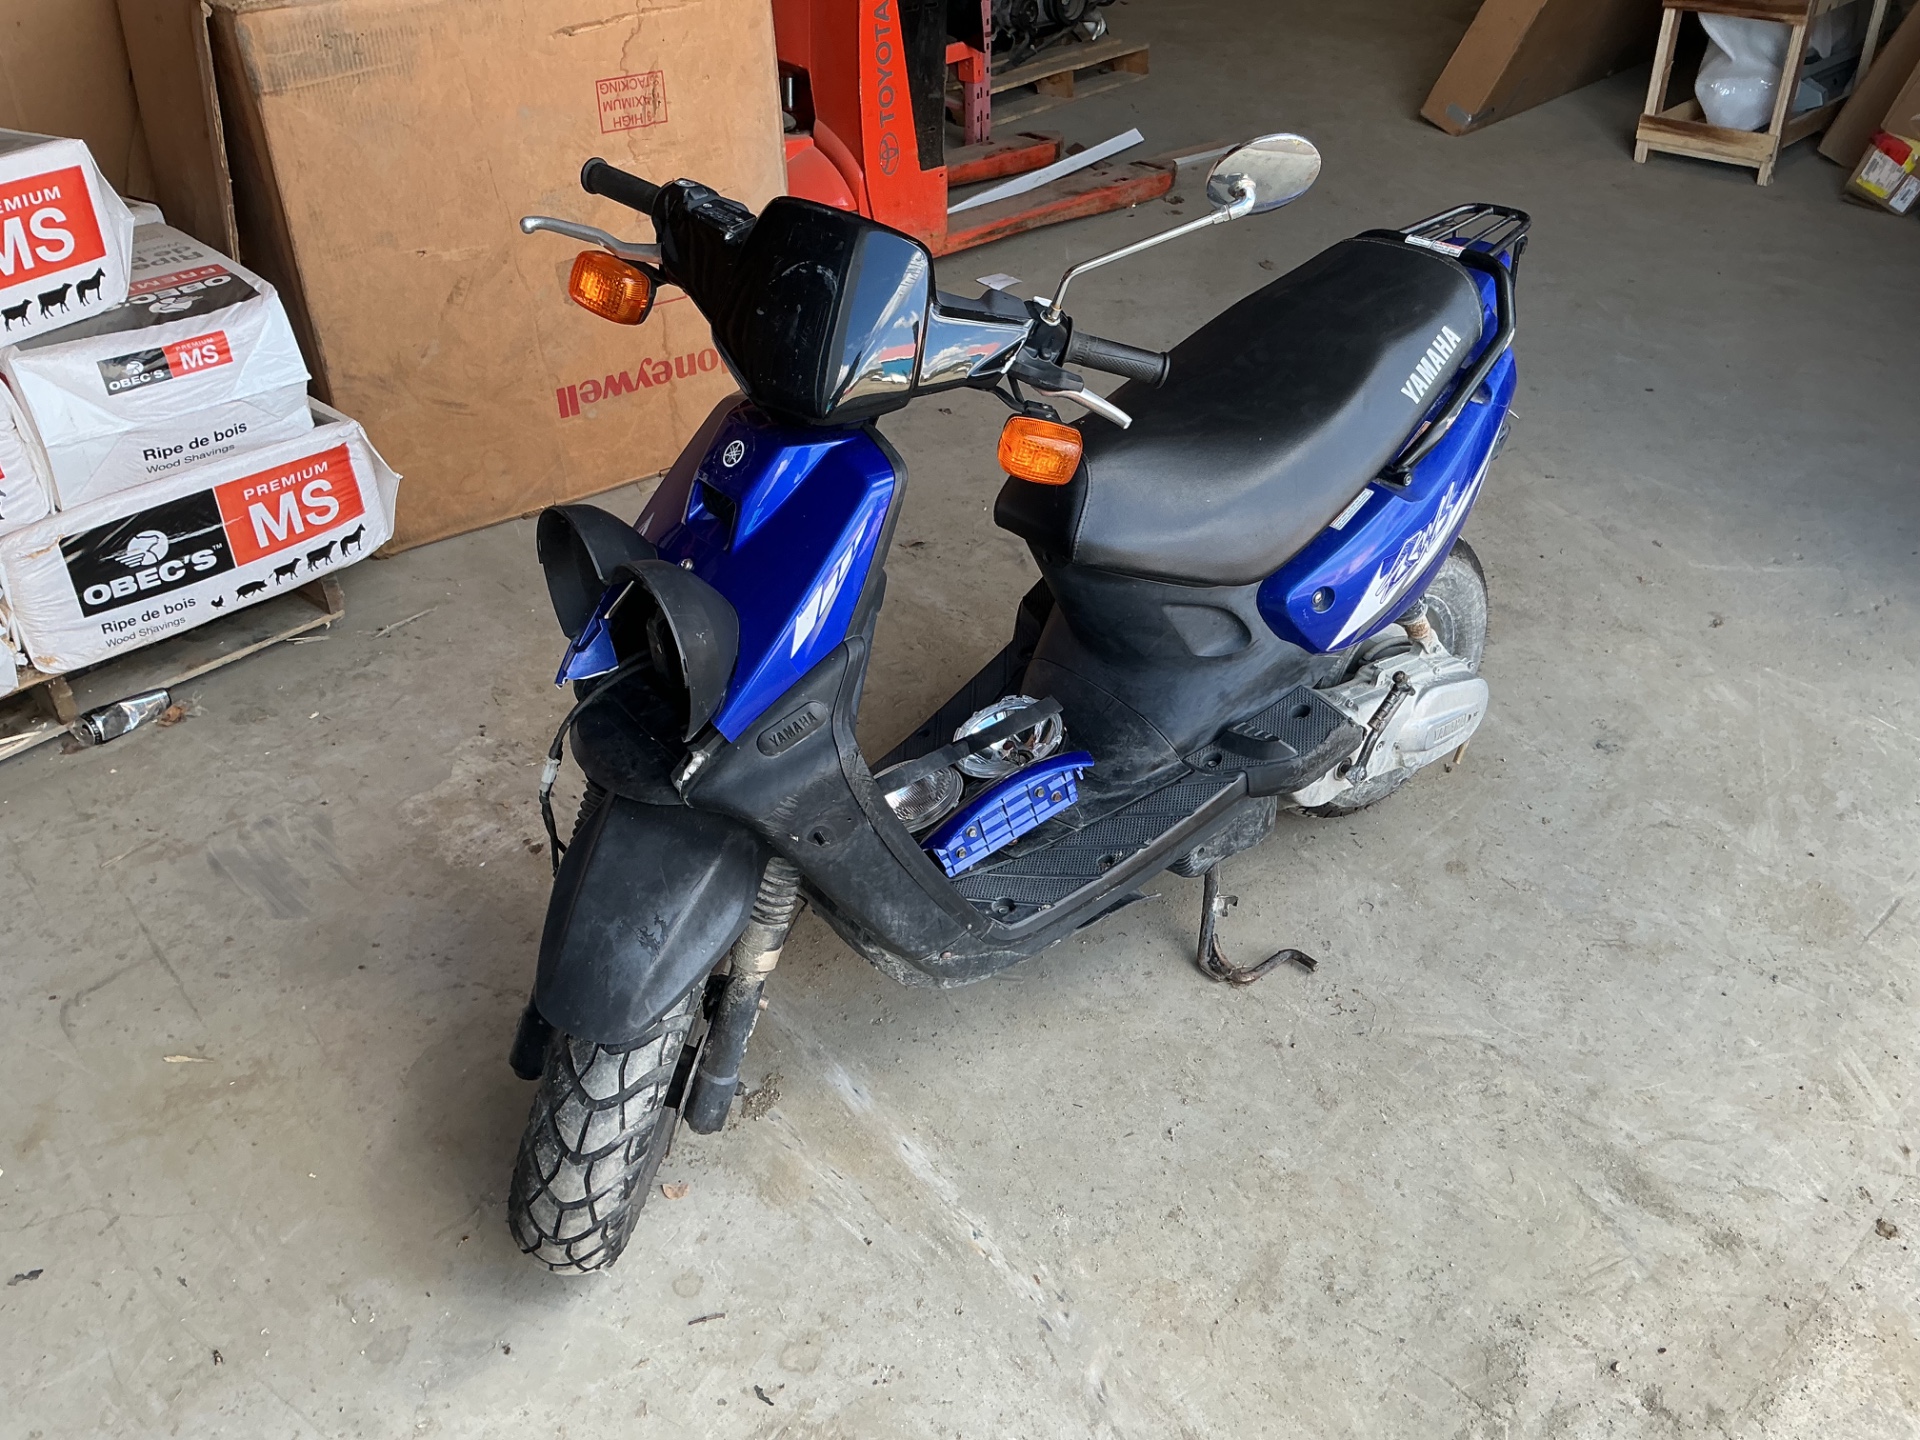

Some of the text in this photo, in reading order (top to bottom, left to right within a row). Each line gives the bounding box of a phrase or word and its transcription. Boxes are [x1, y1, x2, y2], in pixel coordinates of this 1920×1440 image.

[874, 0, 895, 128] TOYOTA
[600, 74, 660, 95] TACKING
[613, 112, 643, 128] HIGH
[175, 337, 214, 352] PREMIUM
[179, 344, 219, 370] MS
[109, 369, 165, 391] OBEC'S
[1401, 325, 1462, 405] YAMAHA
[143, 422, 248, 461] Ripe de bois
[146, 444, 235, 474] Wood Shavings
[243, 461, 328, 501] PREMIUM
[248, 478, 340, 549] MS
[83, 549, 218, 606] OBEC'S
[101, 597, 196, 635] Ripe de bois
[105, 616, 186, 648] Wood Shavings
[768, 711, 818, 747] YAMAHA
